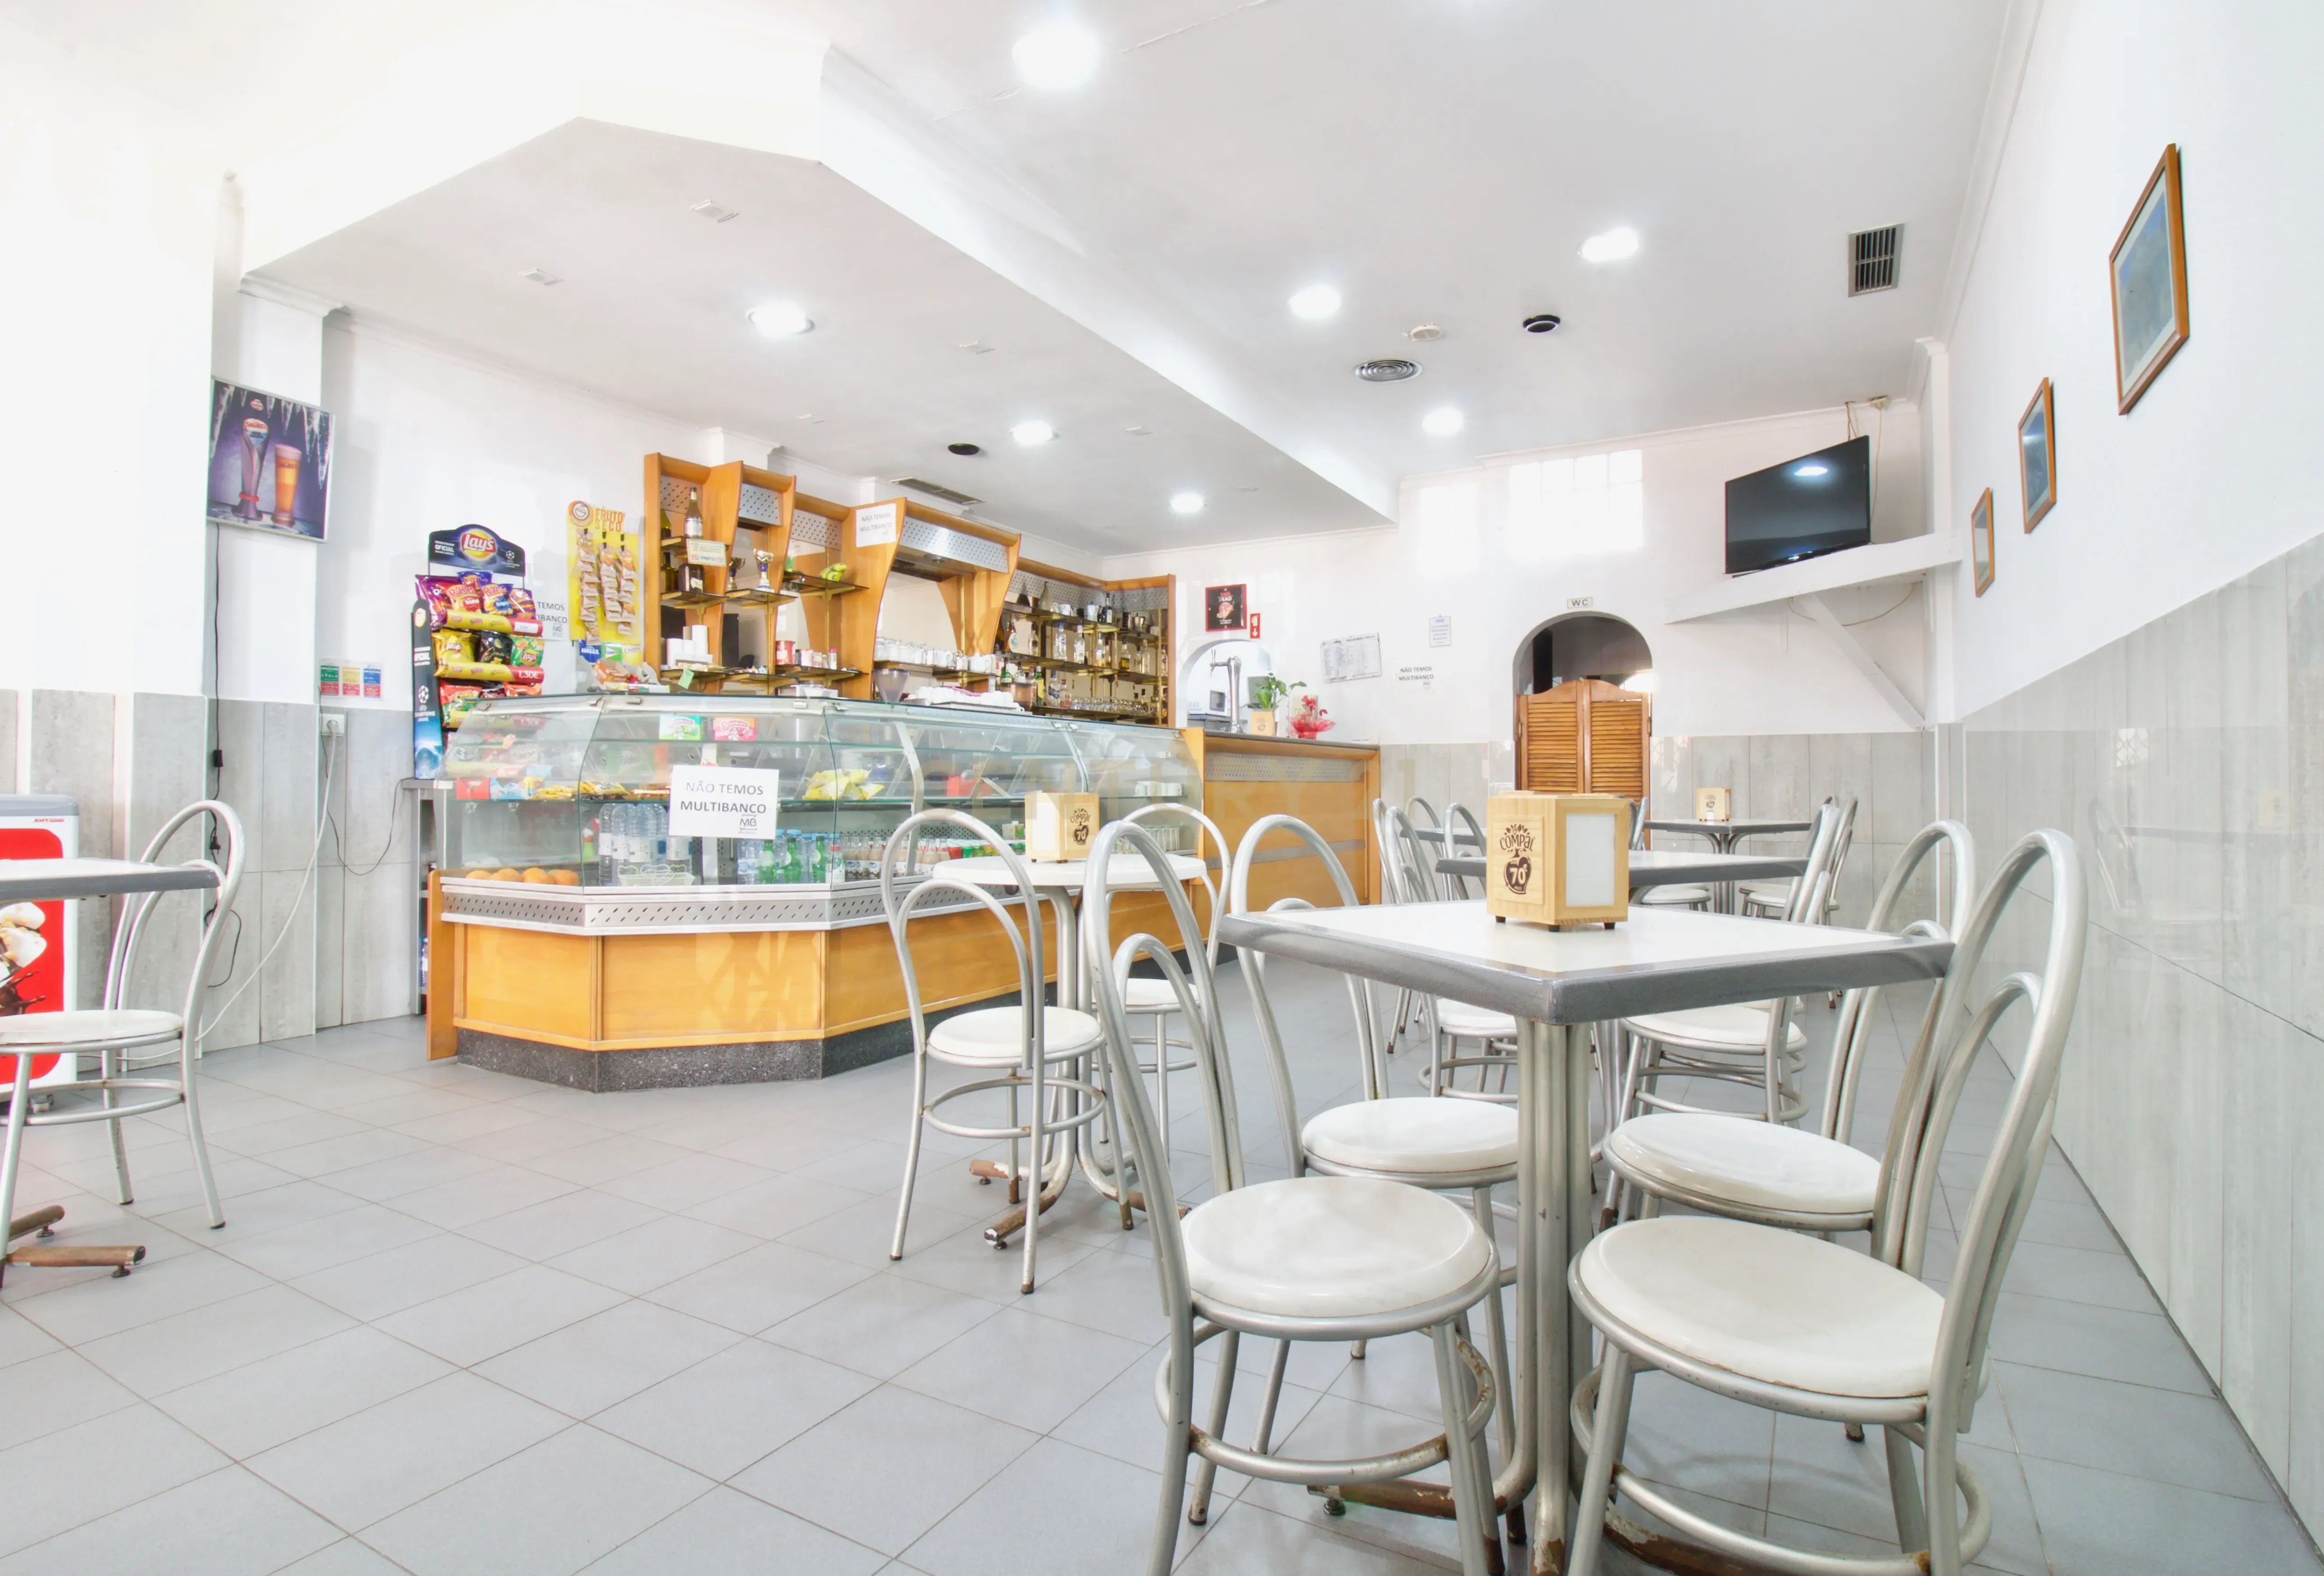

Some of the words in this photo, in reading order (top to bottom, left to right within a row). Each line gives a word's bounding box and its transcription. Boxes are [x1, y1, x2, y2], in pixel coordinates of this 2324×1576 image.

[860, 522, 892, 531] MULTIBANCO
[464, 534, 494, 551] Lay's
[435, 544, 454, 553] OFICIAL
[537, 602, 564, 610] TEMOS
[686, 781, 715, 793] NÃO
[719, 784, 764, 795] TEMOS
[680, 800, 766, 814] MULTIBANCO
[740, 818, 757, 827] MB
[1076, 831, 1086, 840] 70
[1509, 867, 1526, 884] 70
